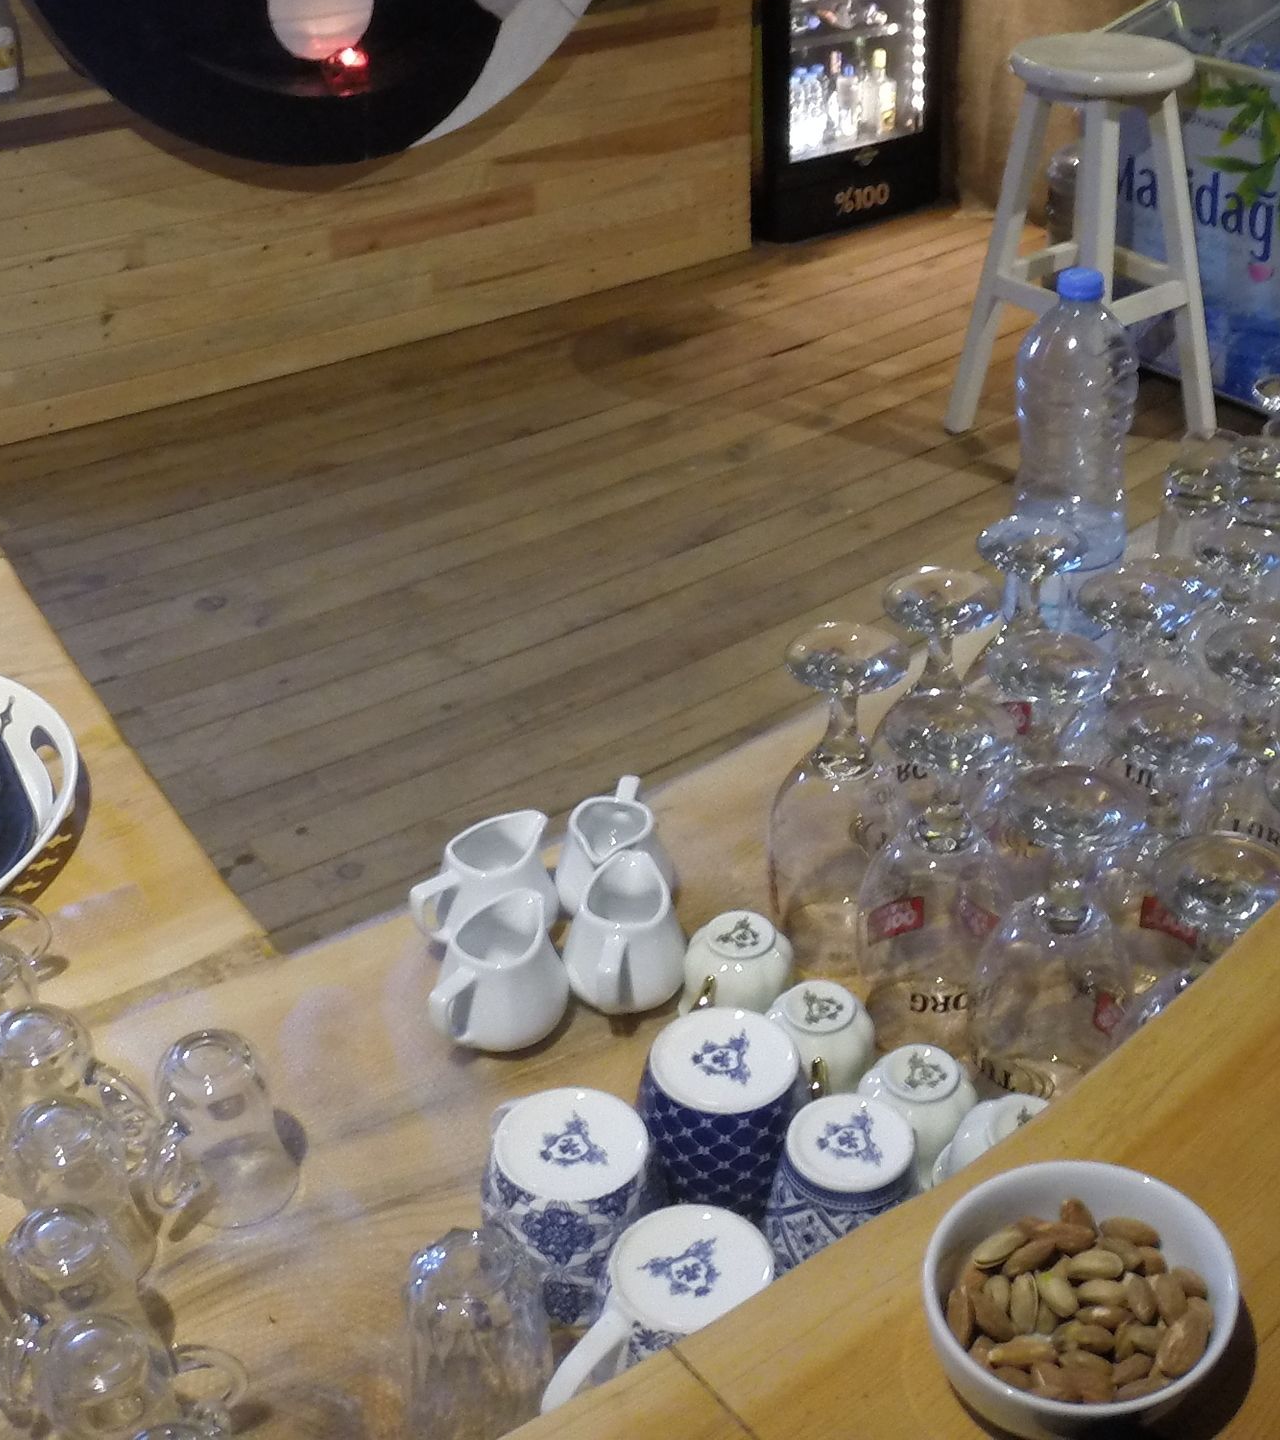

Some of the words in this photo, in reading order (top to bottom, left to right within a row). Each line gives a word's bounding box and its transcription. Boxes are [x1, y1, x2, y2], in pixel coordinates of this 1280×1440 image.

[834, 183, 890, 216] %100
[1117, 154, 1277, 262] Maidağ
[909, 991, 968, 1014] ORG
